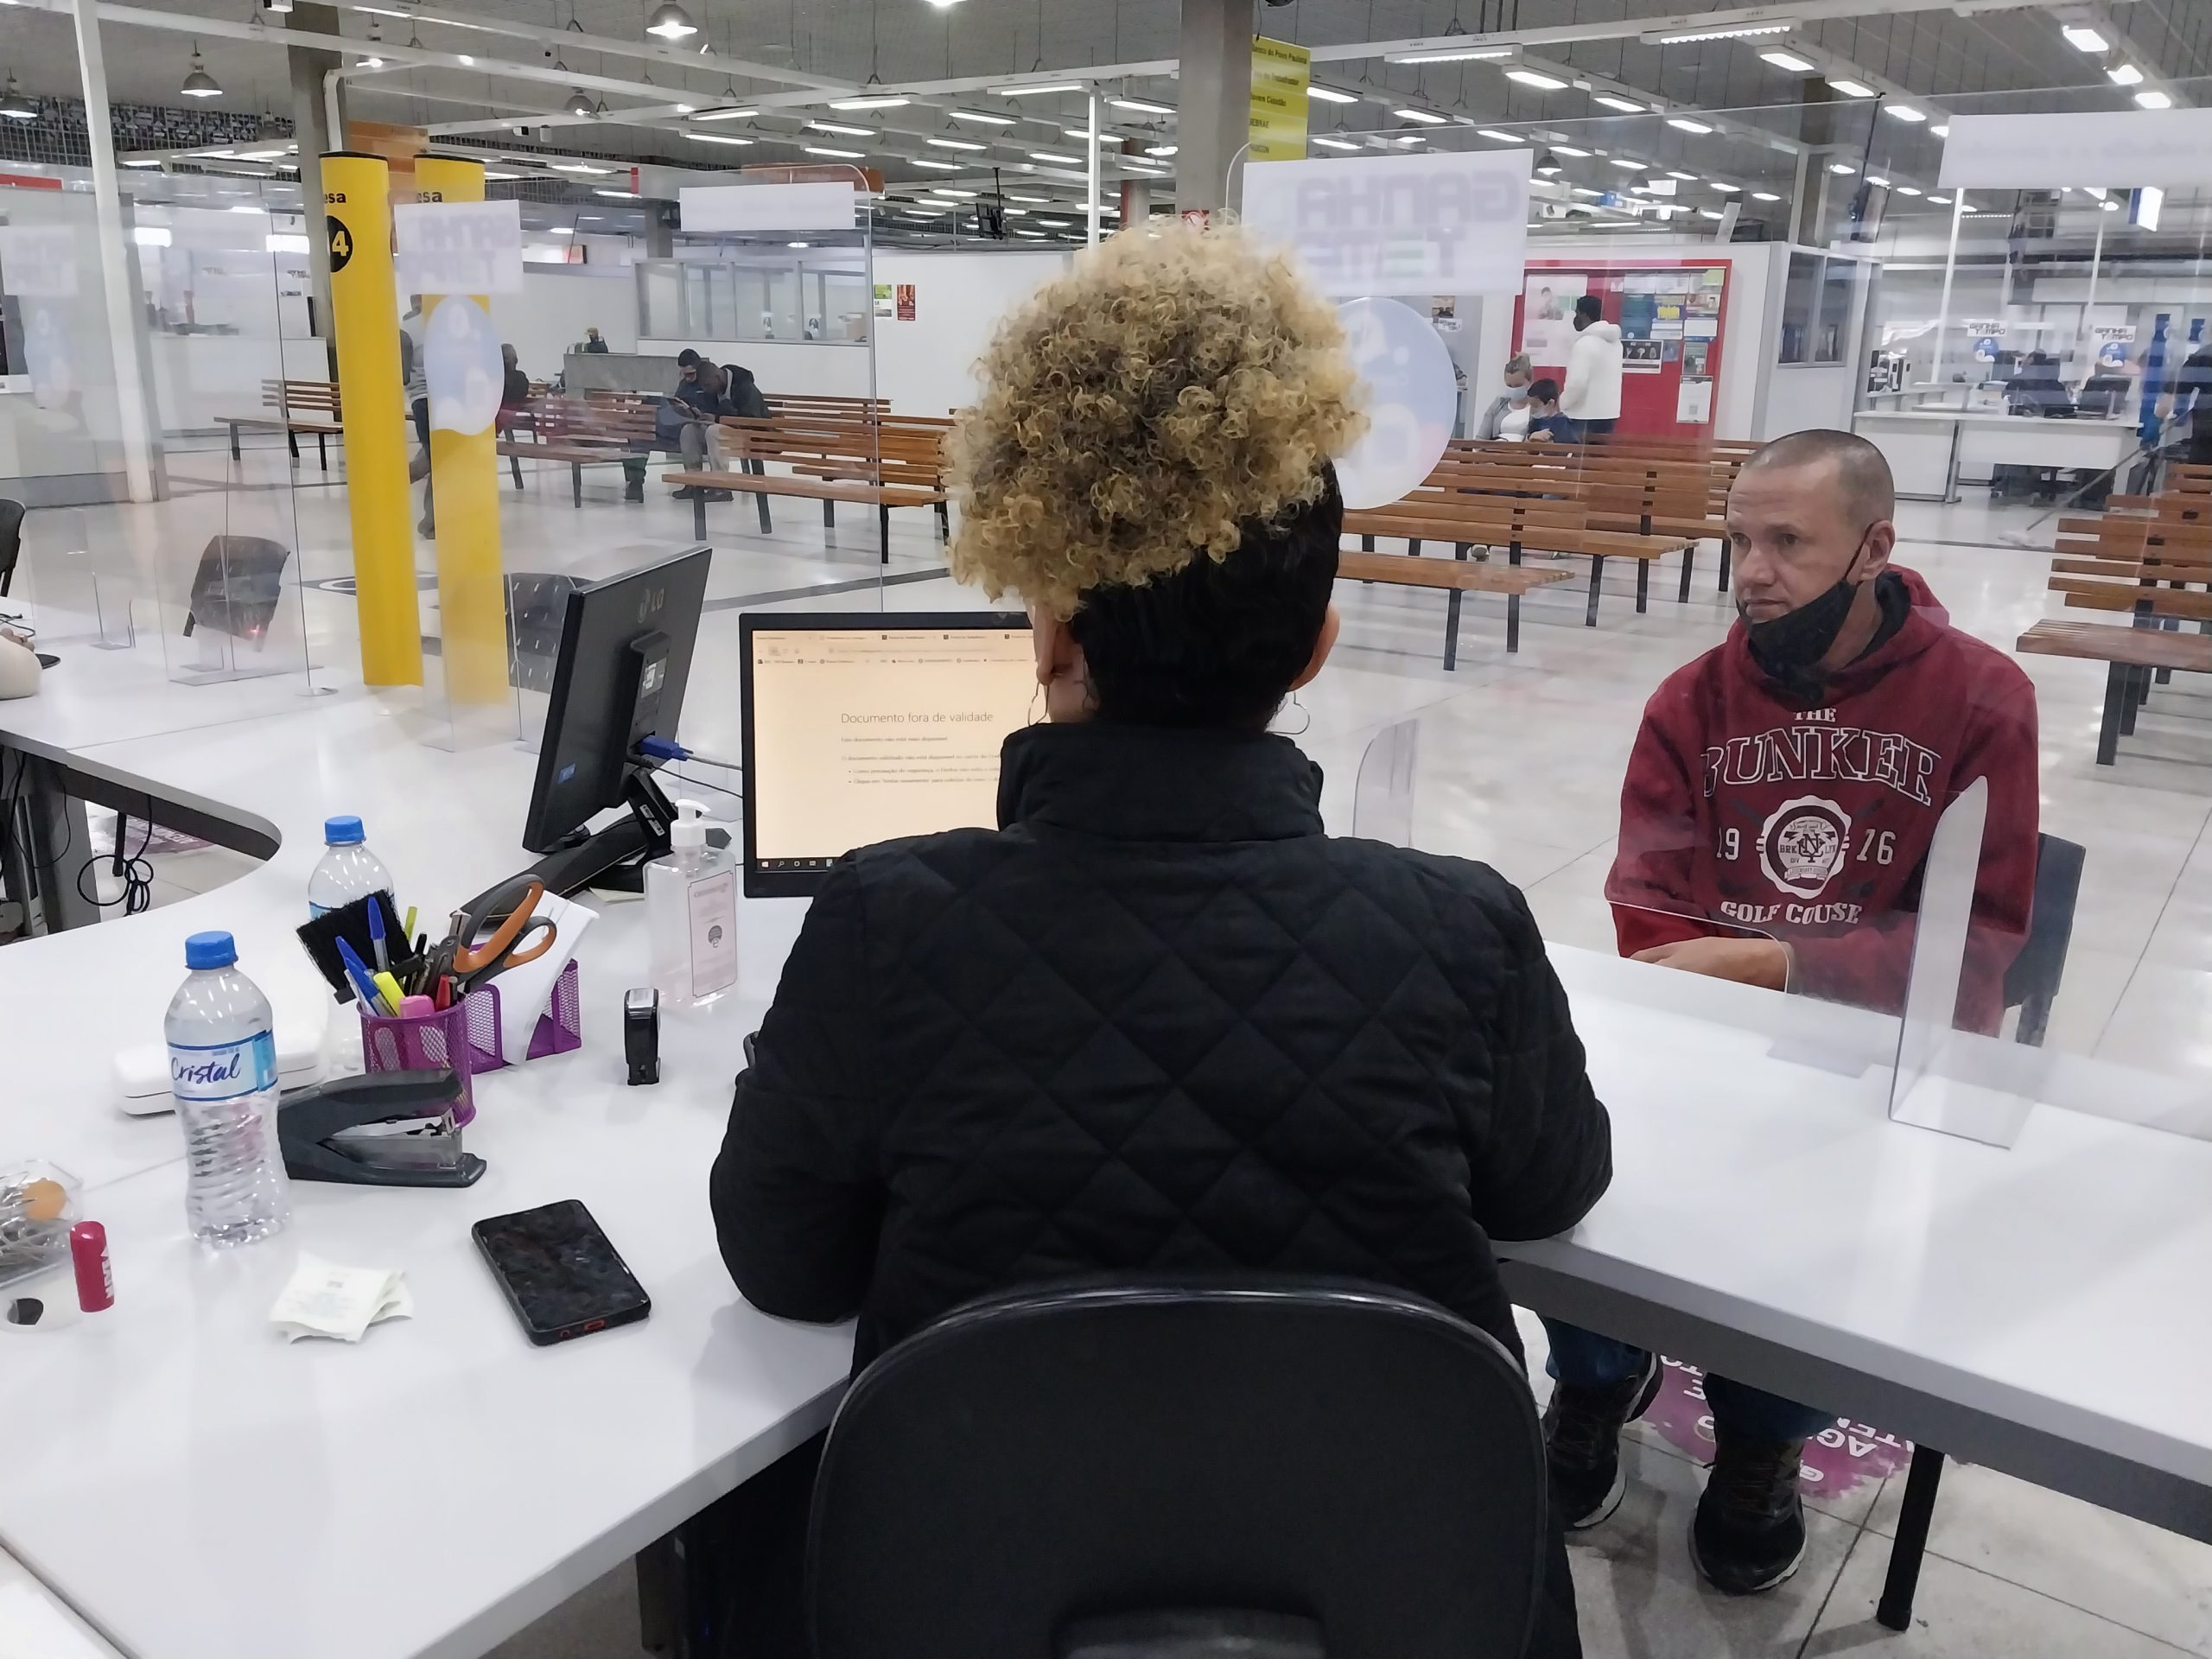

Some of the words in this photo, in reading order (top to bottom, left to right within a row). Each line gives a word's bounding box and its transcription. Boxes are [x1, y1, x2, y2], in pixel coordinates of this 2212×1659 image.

[841, 713, 905, 723] Documento
[908, 712, 929, 722] fora
[932, 712, 946, 722] de
[950, 711, 994, 722] validade
[1793, 708, 1836, 722] THE
[1720, 900, 1781, 923] GOLF
[171, 1053, 241, 1084] Cristal
